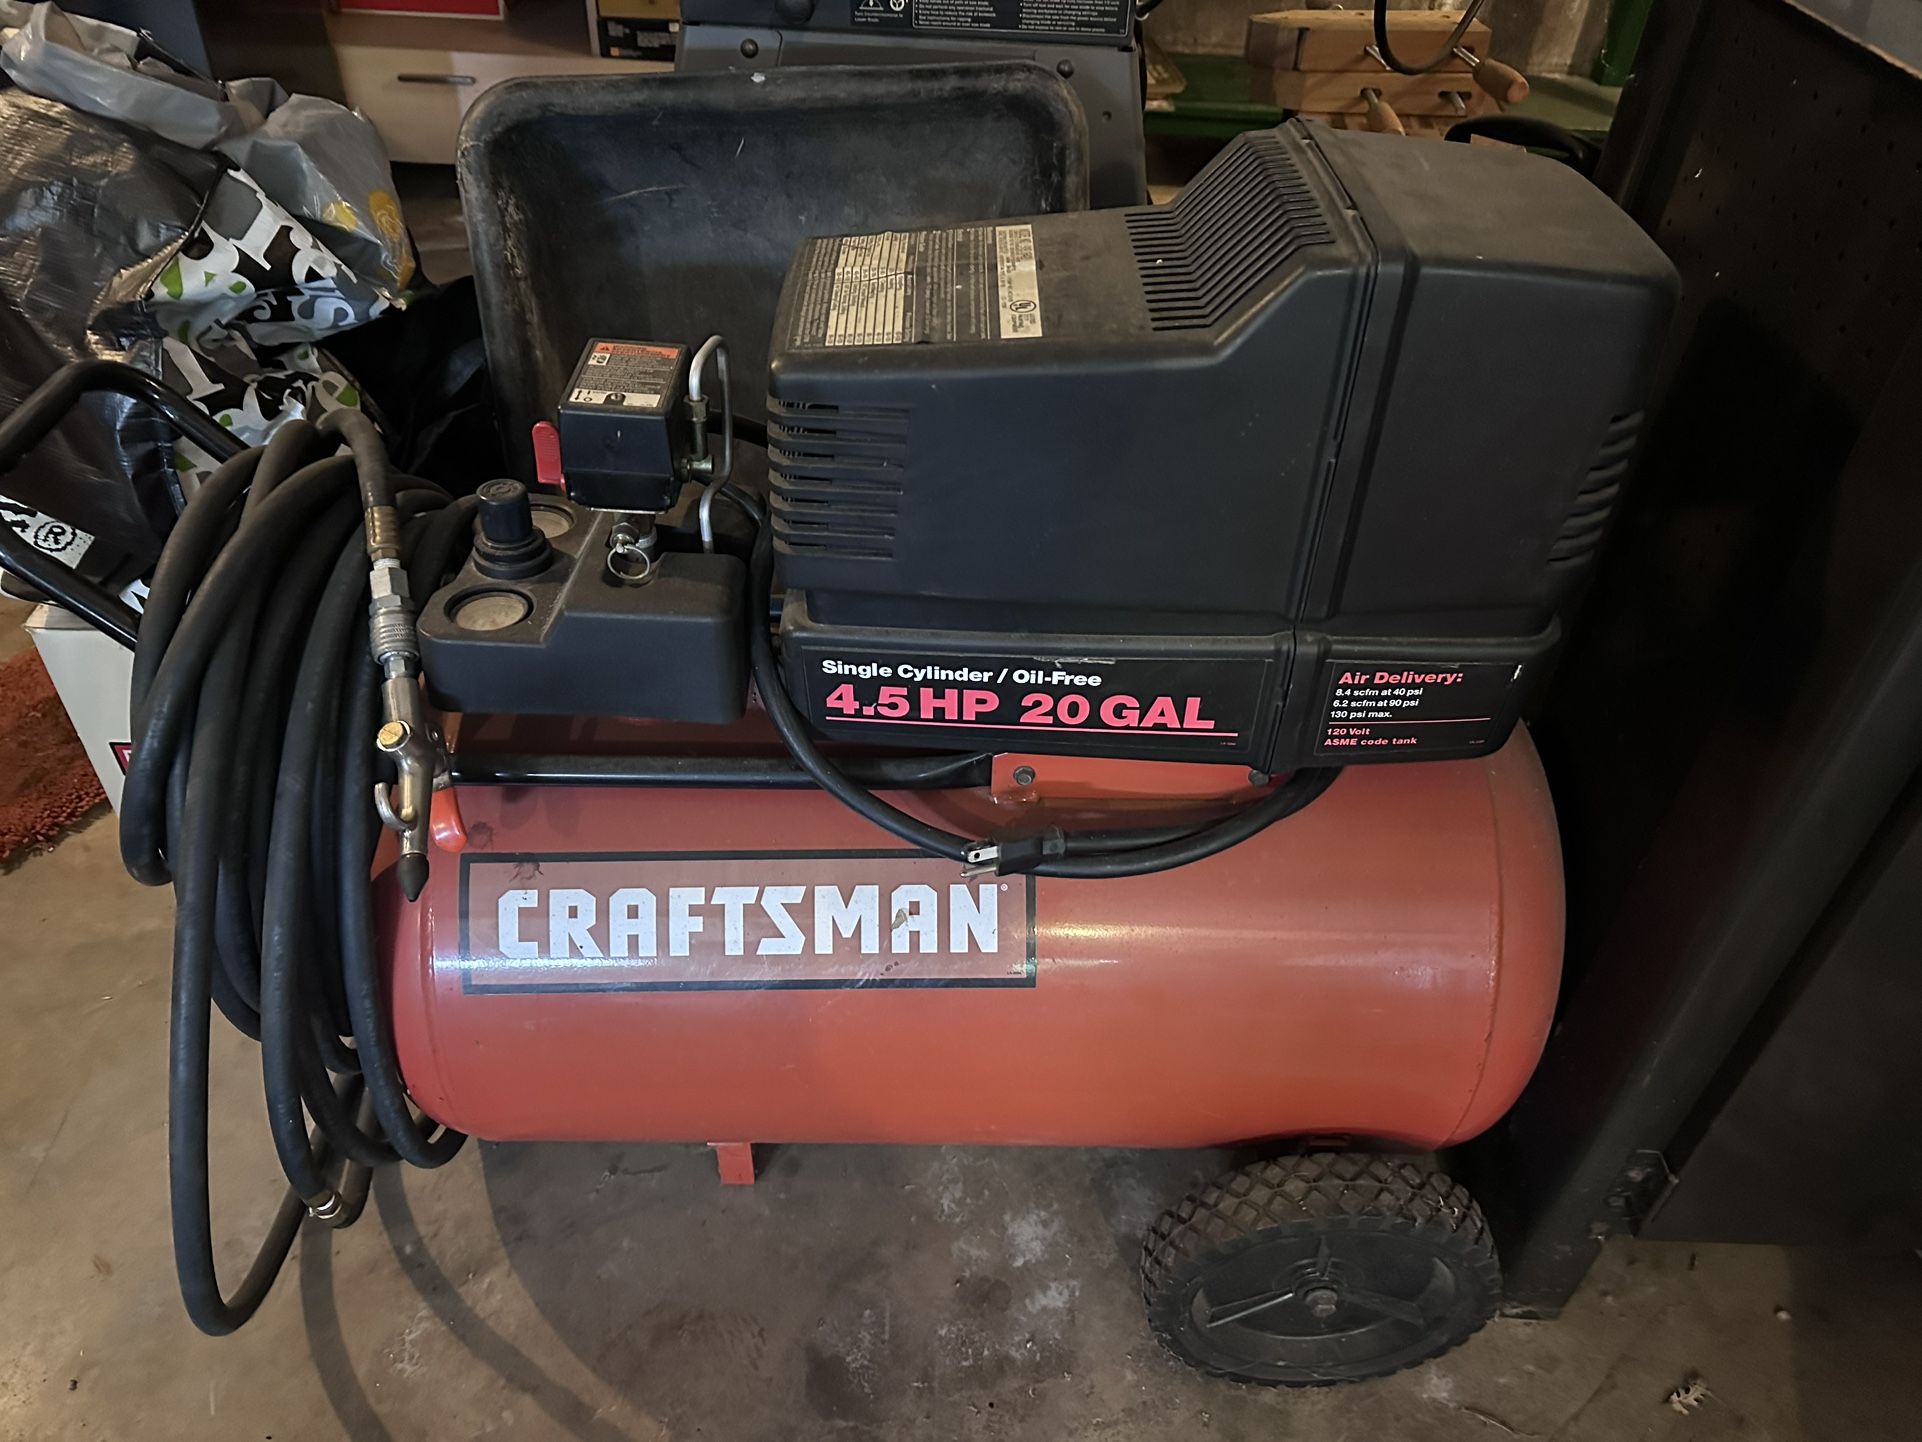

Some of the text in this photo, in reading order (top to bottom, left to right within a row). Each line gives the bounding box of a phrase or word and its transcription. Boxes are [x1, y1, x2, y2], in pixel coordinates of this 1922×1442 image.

[822, 660, 893, 679] Single
[897, 664, 994, 683] Cylinder
[1012, 668, 1103, 687] Oil-Free
[1338, 671, 1464, 686] Air Delivery:
[1335, 687, 1423, 698] 8.4 scfm at 40 psi
[825, 684, 1216, 729] 4.5 HP 20 GAL
[1332, 698, 1419, 709] 6.2 scfm at 90 psi
[1330, 710, 1393, 720] 130 psi max.
[1327, 727, 1370, 736] 120 Volt
[1324, 736, 1418, 746] ASME code tank
[497, 882, 999, 958] CRAFTSMAN
